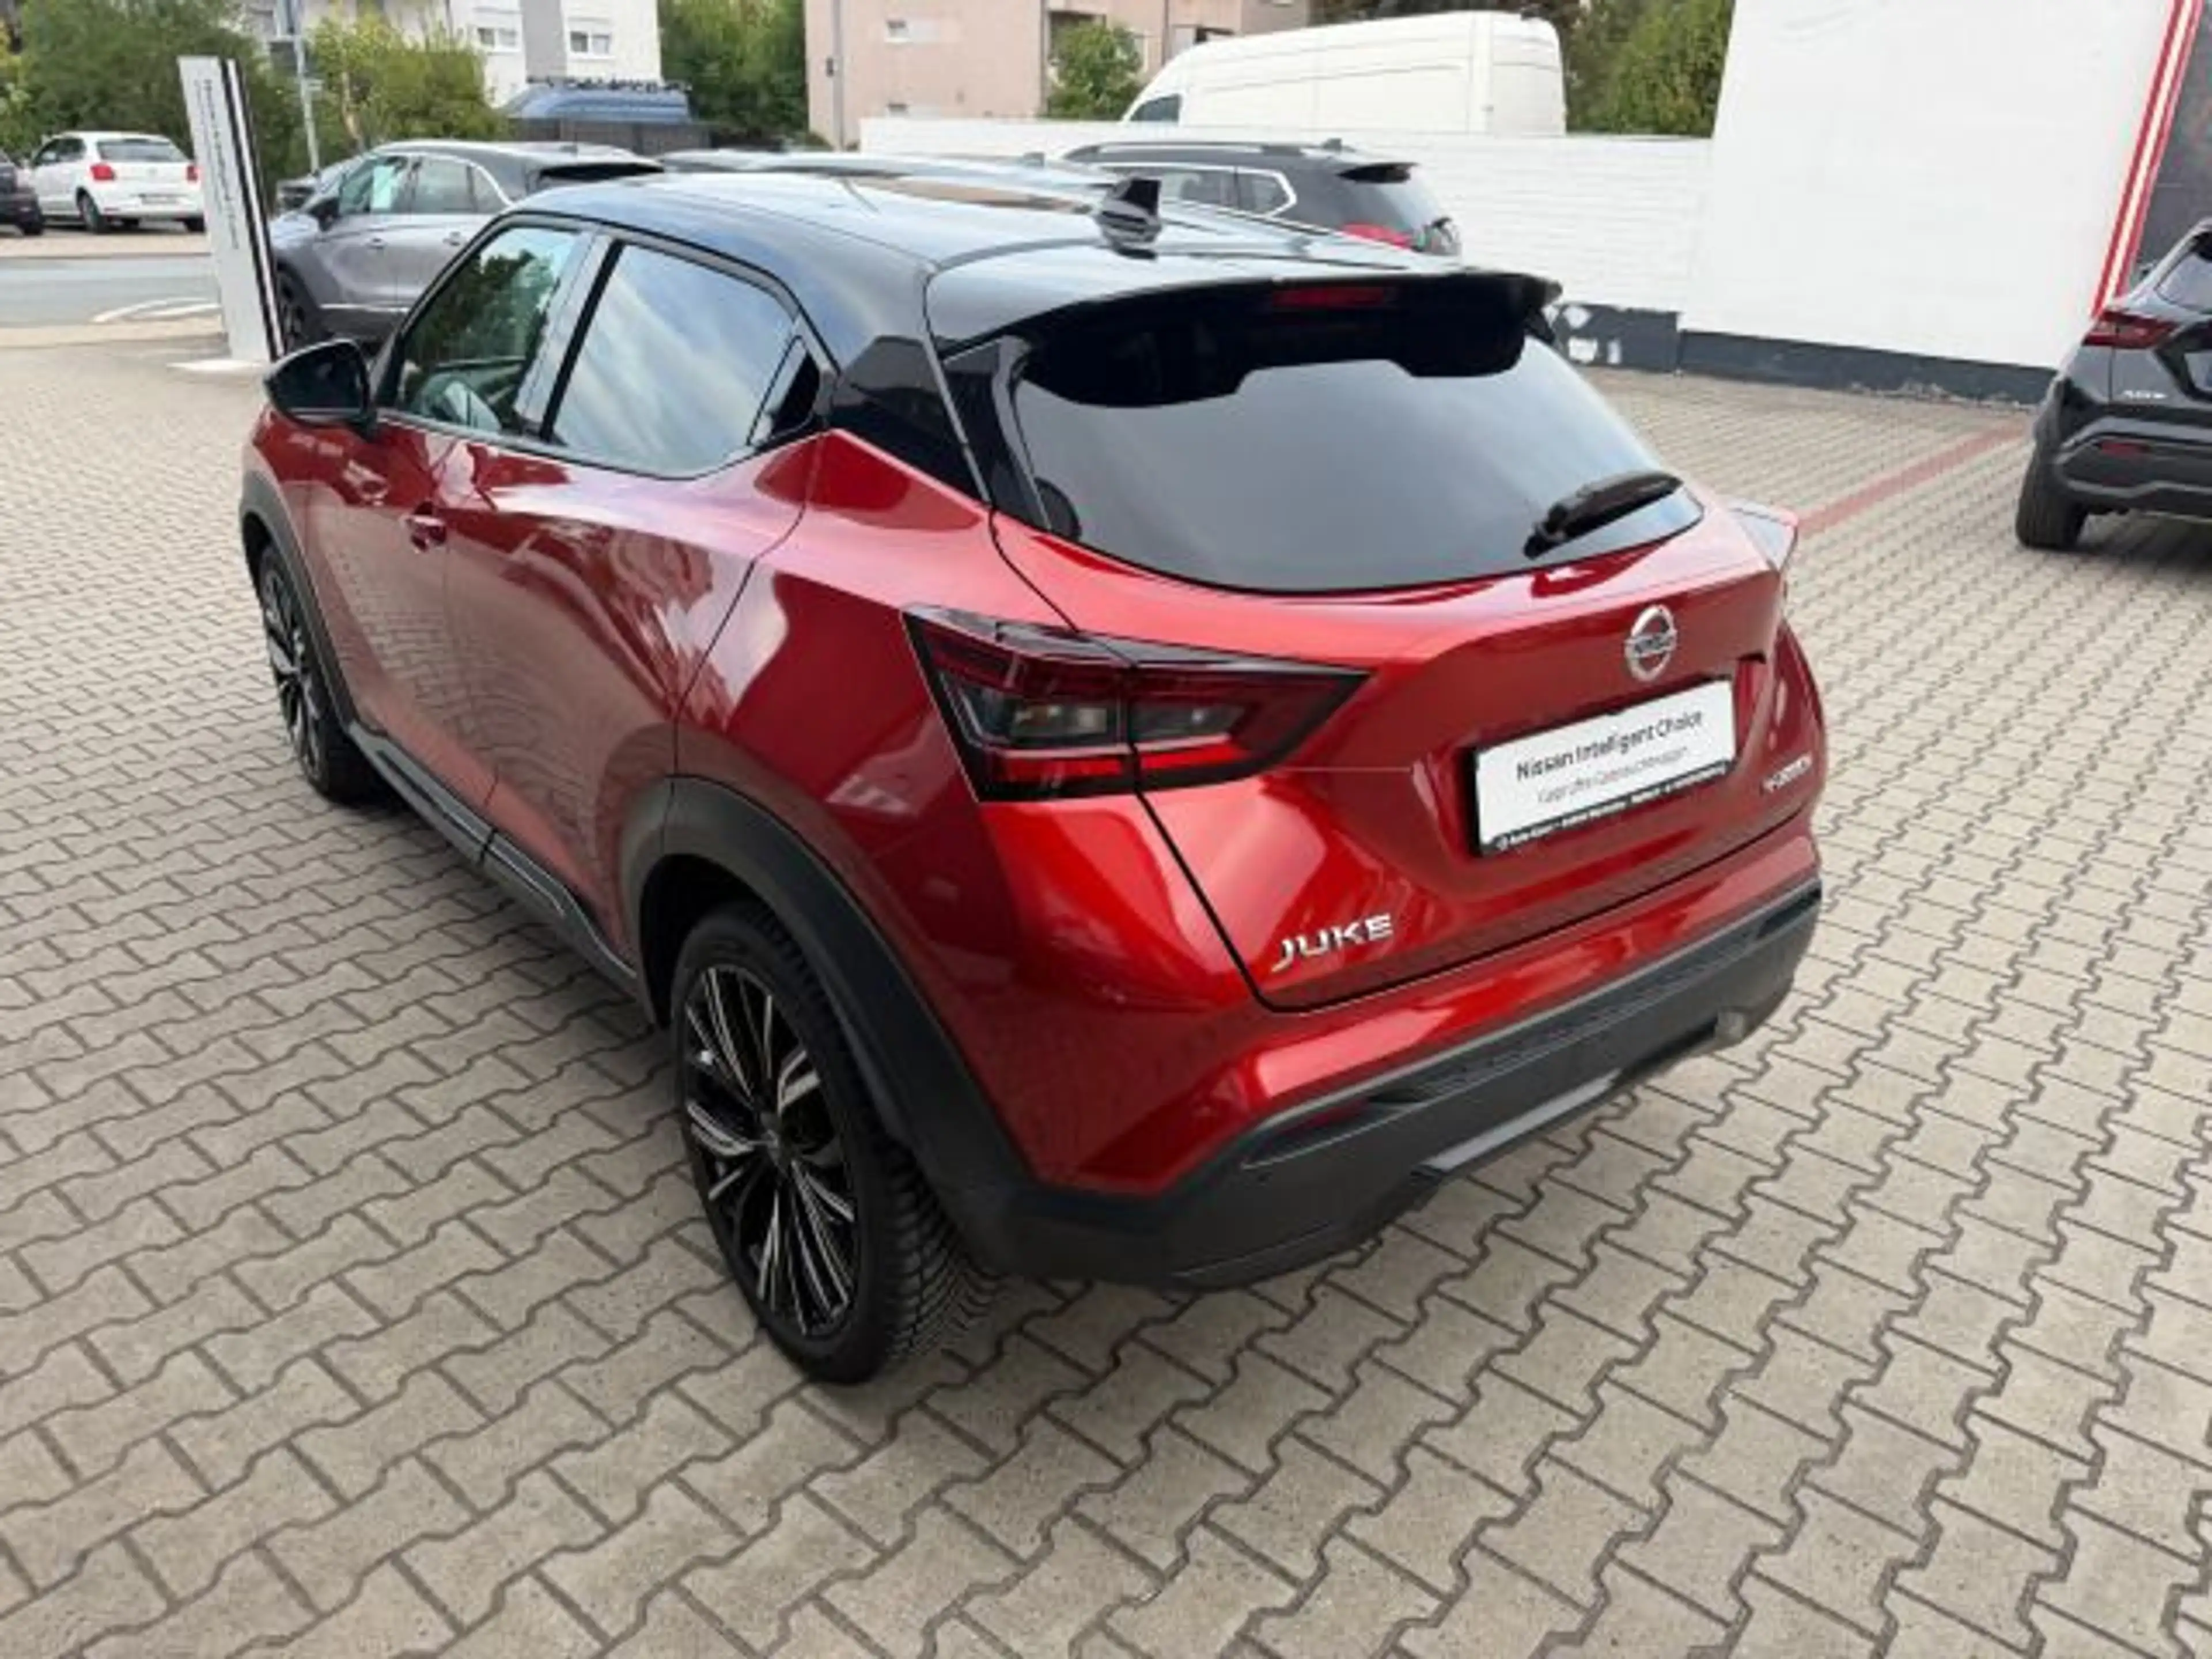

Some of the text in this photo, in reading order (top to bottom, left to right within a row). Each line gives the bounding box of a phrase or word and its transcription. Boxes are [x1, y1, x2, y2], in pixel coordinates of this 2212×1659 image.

[1516, 751, 1574, 782] Nissan
[1575, 725, 1653, 764] Intelligent
[1654, 710, 1702, 738] Choice
[1271, 912, 1393, 972] JUKE
